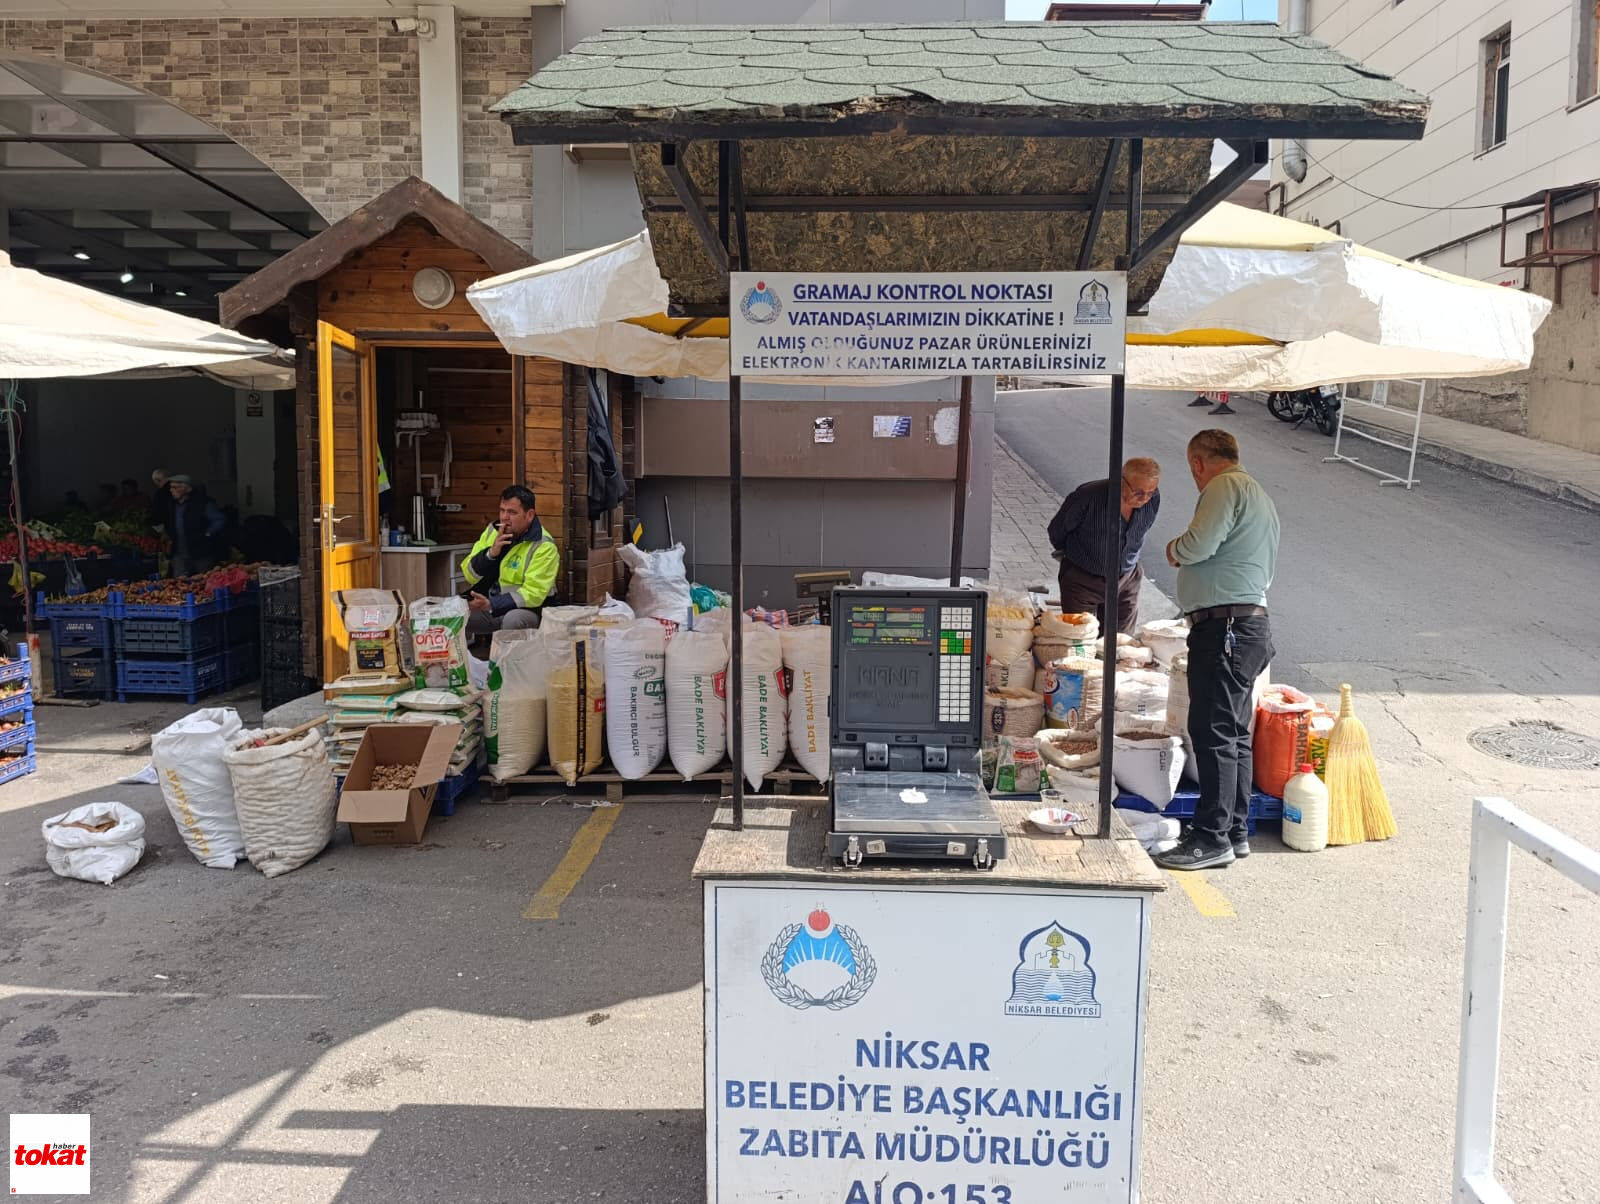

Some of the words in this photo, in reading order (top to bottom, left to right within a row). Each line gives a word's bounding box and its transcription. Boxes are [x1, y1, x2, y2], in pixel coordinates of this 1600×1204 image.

[793, 283, 872, 300] GRAMAJ
[877, 283, 967, 300] KONTROL
[971, 283, 1053, 300] NOKTASI
[787, 311, 960, 331] VATANDAŞLARIMIZIN
[965, 307, 1055, 327] DİKKATİNE
[757, 335, 806, 353] ALMIŞ
[919, 336, 972, 351] PAZAR
[976, 332, 1092, 351] ÜRÜNLERİNİZİ
[847, 356, 968, 370] KANTARIMIZLA
[971, 353, 1107, 370] TARTABİLİRSİNİZ
[694, 676, 703, 704] BADE
[758, 675, 768, 703] BADE
[695, 707, 707, 756] BAKLİYAT
[807, 725, 817, 753] BADE
[1008, 1004, 1042, 1015] NİKSAR
[855, 1030, 991, 1072] NİKSAR
[725, 1074, 892, 1113] BELEDİYE
[903, 1084, 1122, 1125] BAŞKANLIĞI
[739, 1127, 866, 1160] ZABITA
[875, 1126, 1110, 1169] MÜDÜRLÜĞÜ
